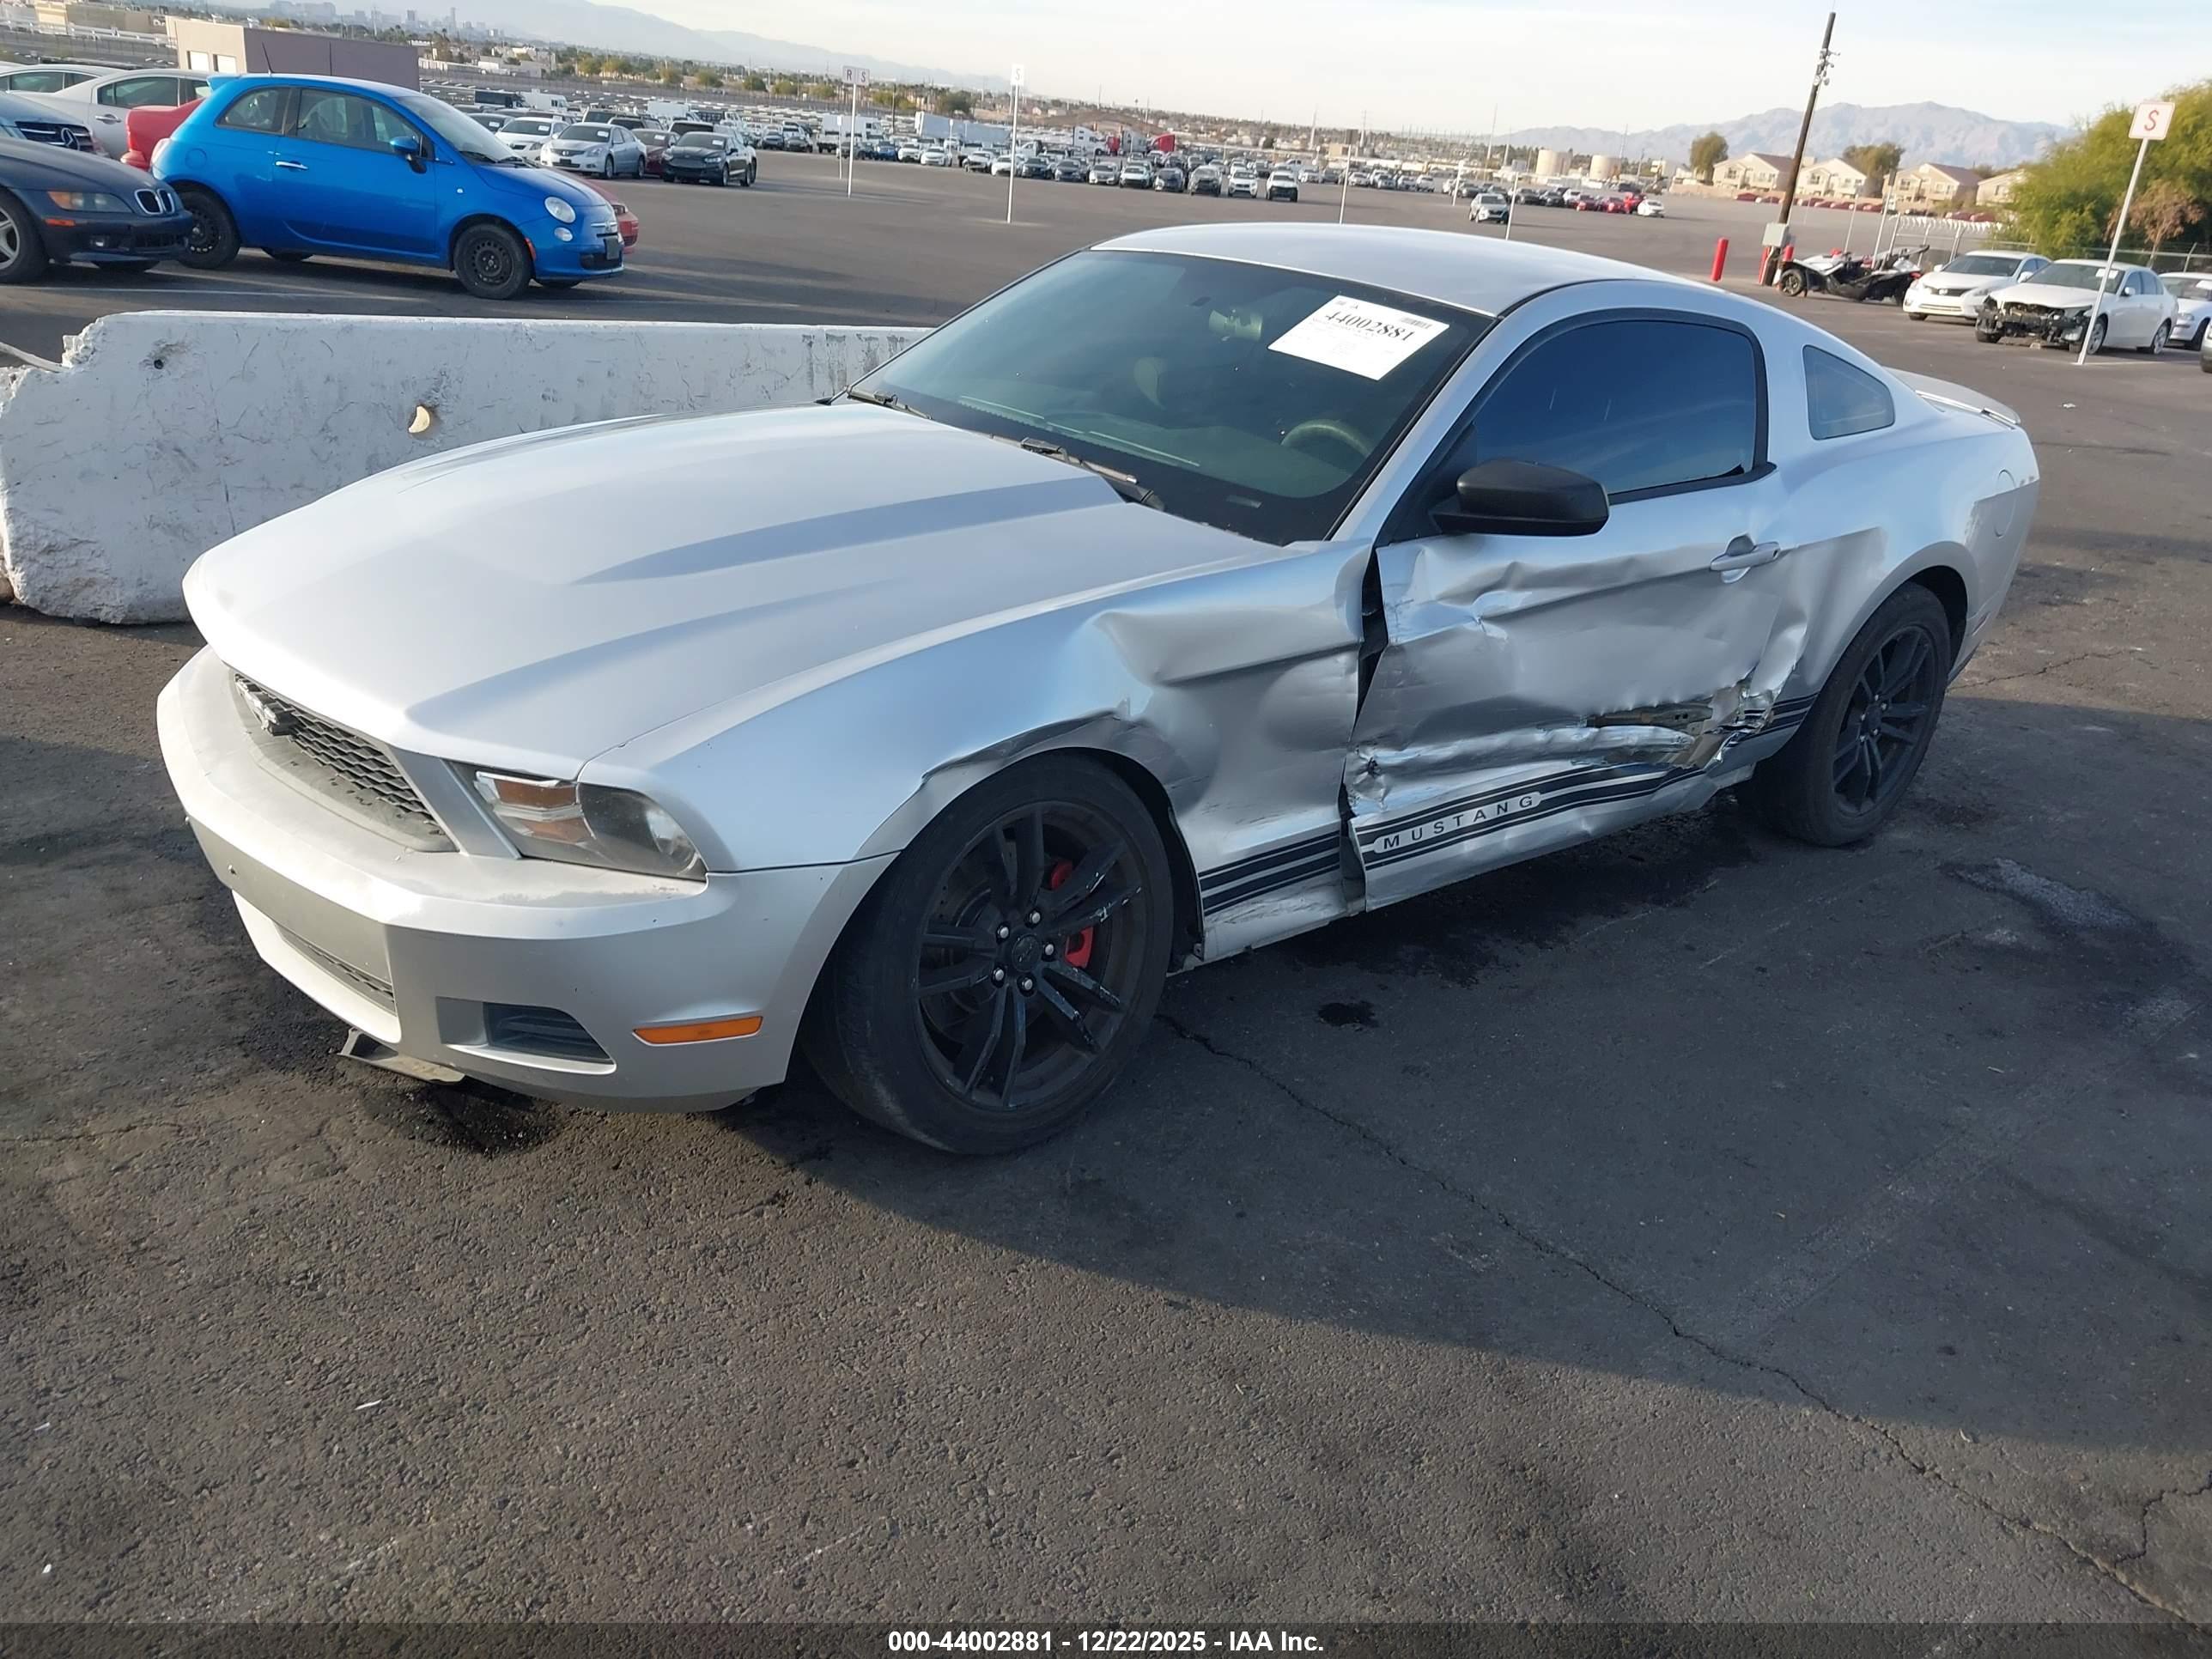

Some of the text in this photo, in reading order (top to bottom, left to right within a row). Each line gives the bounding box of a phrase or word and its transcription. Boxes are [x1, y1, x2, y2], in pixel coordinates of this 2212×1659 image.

[2144, 109, 2160, 131] S
[1325, 310, 1415, 341] 44002881
[1382, 795, 1534, 850] MUSTANG
